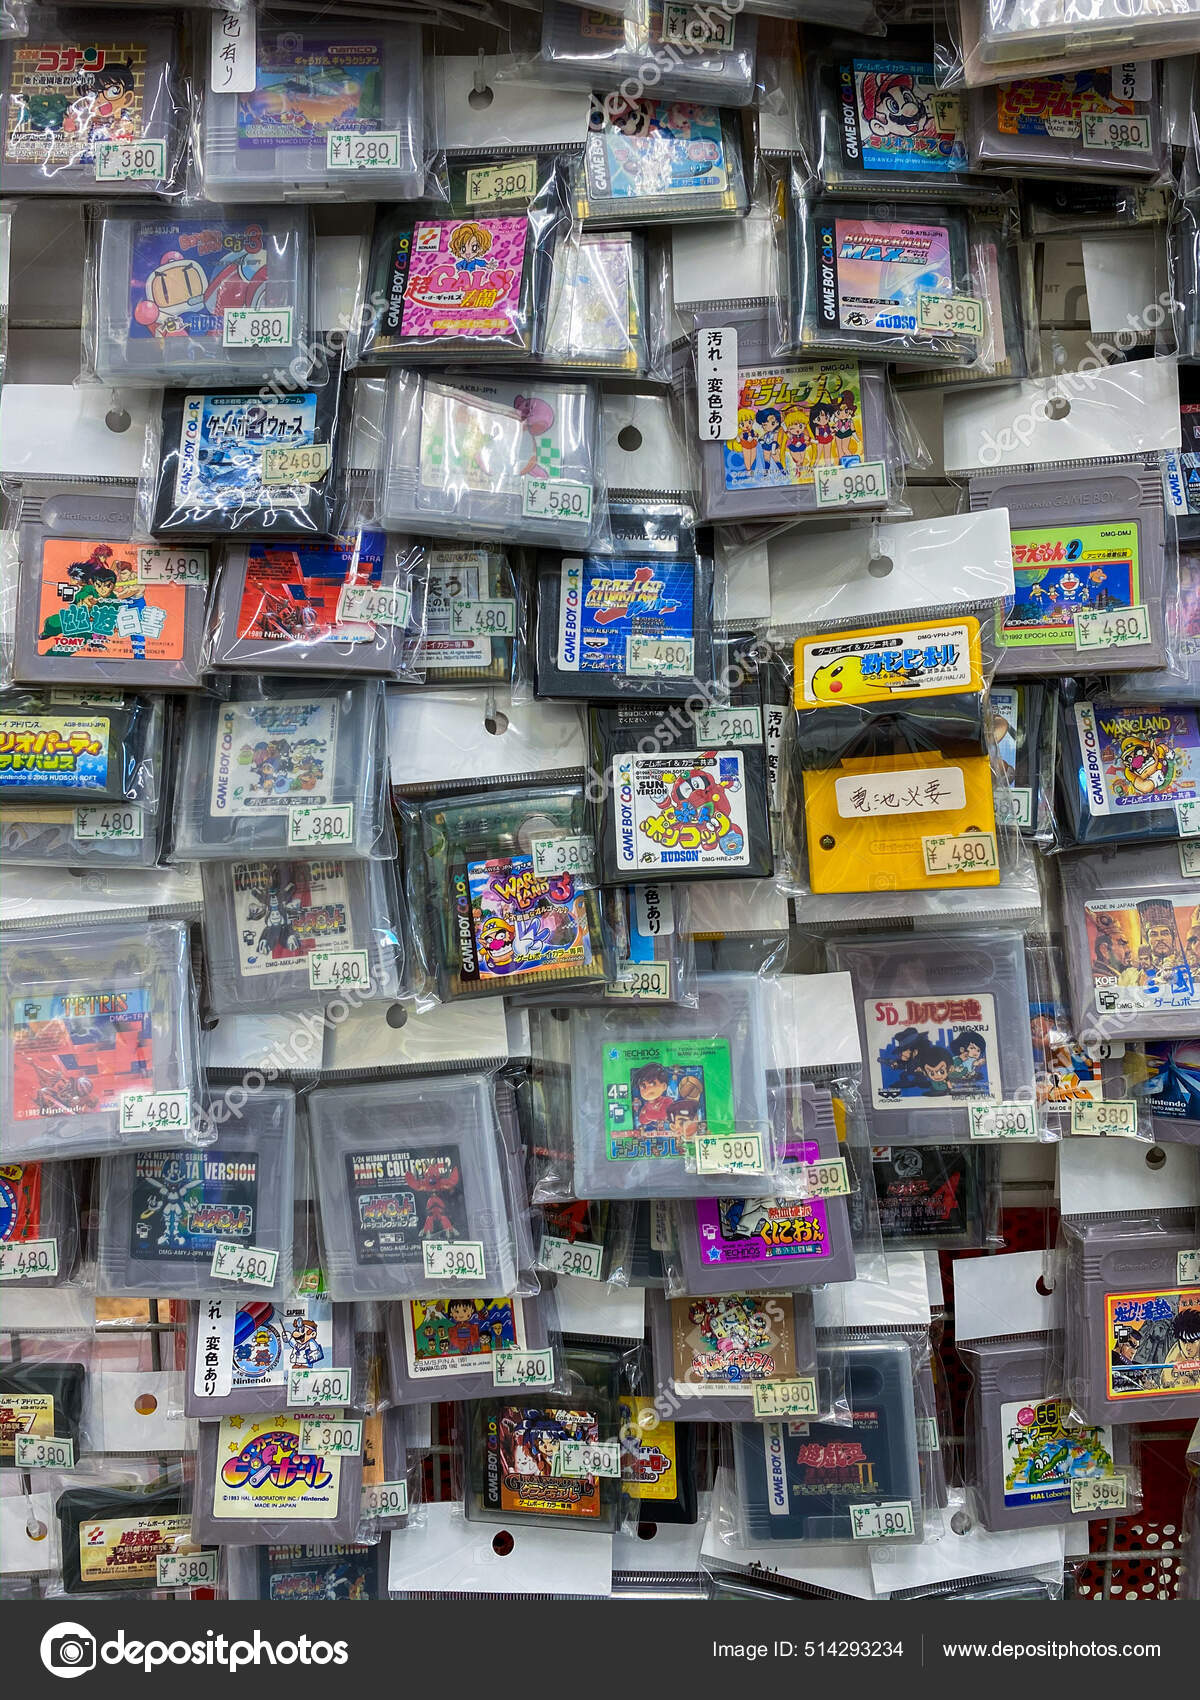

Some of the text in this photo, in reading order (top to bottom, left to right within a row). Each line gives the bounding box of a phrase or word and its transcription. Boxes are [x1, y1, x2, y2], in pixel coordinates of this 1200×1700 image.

[35, 47, 105, 72] コナン
[838, 244, 905, 263] MAX
[394, 271, 405, 293] BOY
[823, 265, 834, 288] BOY
[388, 293, 402, 328] GAME
[824, 289, 836, 321] GAME
[707, 331, 723, 439] 汚れ・変色あり
[59, 603, 167, 640] 幽遊白書
[564, 568, 580, 663] GAME BOY COLOR
[54, 638, 84, 646] TOMY
[860, 644, 957, 676] ポケモンピンボール
[220, 754, 231, 776] BOY
[1081, 708, 1104, 805] GAME BOY COLOR
[217, 777, 229, 808] GAME
[636, 788, 667, 796] VERSION
[639, 780, 665, 789] SUN
[849, 779, 952, 813] 電池必要
[620, 763, 634, 861] GAME BOY COLOR
[660, 849, 699, 863] HUDSON
[516, 881, 551, 909] LAND
[459, 914, 471, 936] BOY
[461, 938, 475, 973] GAME
[1095, 976, 1117, 986] KOEI
[61, 993, 129, 1017] TETRIS
[204, 1162, 256, 1182] VERSION
[353, 1163, 384, 1180] PARTS
[233, 1377, 272, 1385] Nintendo
[488, 1450, 498, 1466] BOY
[488, 1466, 498, 1502] GAME
[772, 1456, 785, 1506] GAME BOY
[1030, 1493, 1046, 1501] HAL
